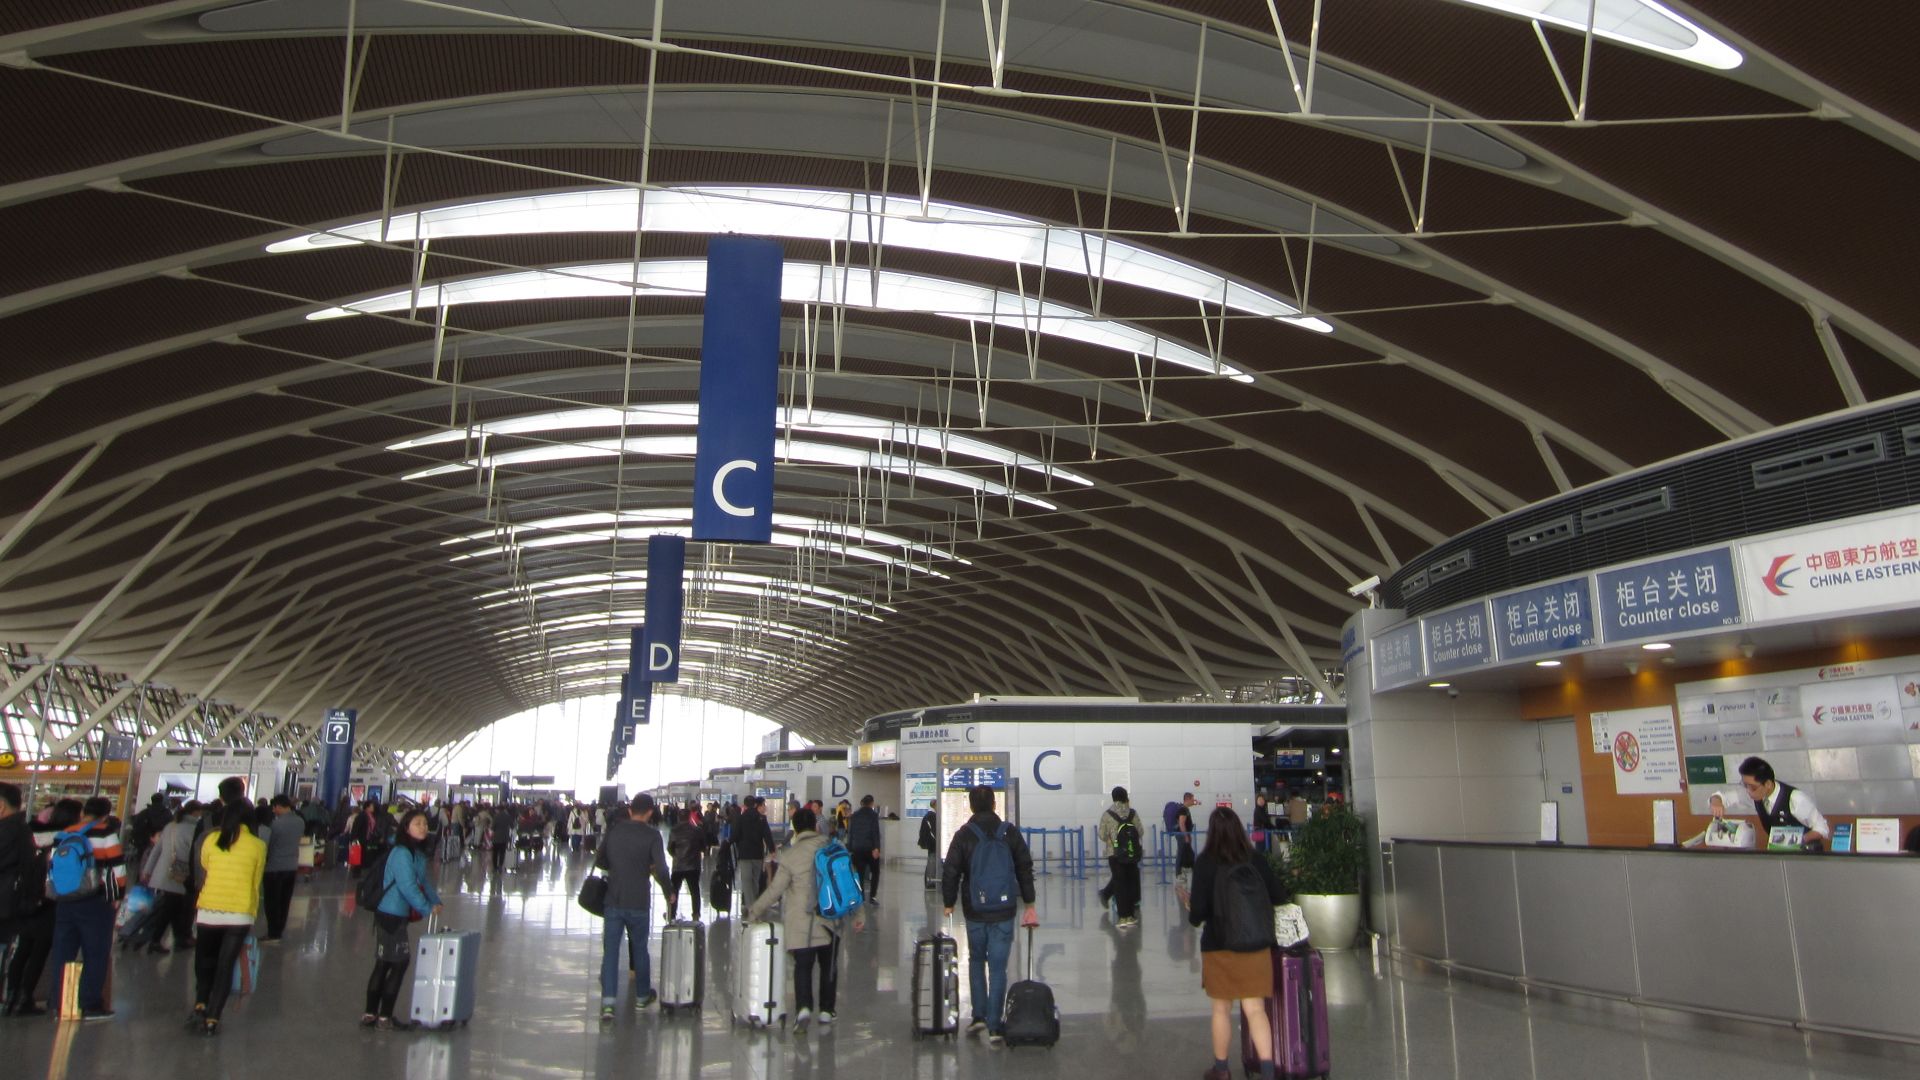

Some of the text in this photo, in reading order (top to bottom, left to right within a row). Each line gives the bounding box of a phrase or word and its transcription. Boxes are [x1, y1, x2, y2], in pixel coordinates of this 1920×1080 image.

[712, 459, 758, 518] C
[1806, 538, 1919, 571] 中國東方航空
[1616, 565, 1717, 610] 柜台关闭
[1809, 561, 1920, 588] CHINA EASTERN
[1506, 592, 1580, 631] 柜台关闭
[1619, 600, 1719, 627] Counter close
[1432, 615, 1481, 648] 柜台关闭
[1509, 623, 1582, 646] Counter close
[649, 642, 673, 671] D
[1433, 643, 1482, 663] Counter close
[632, 699, 646, 718] E
[622, 726, 633, 741] F
[965, 727, 975, 743] C
[1033, 749, 1063, 791] C
[832, 775, 850, 798] D
